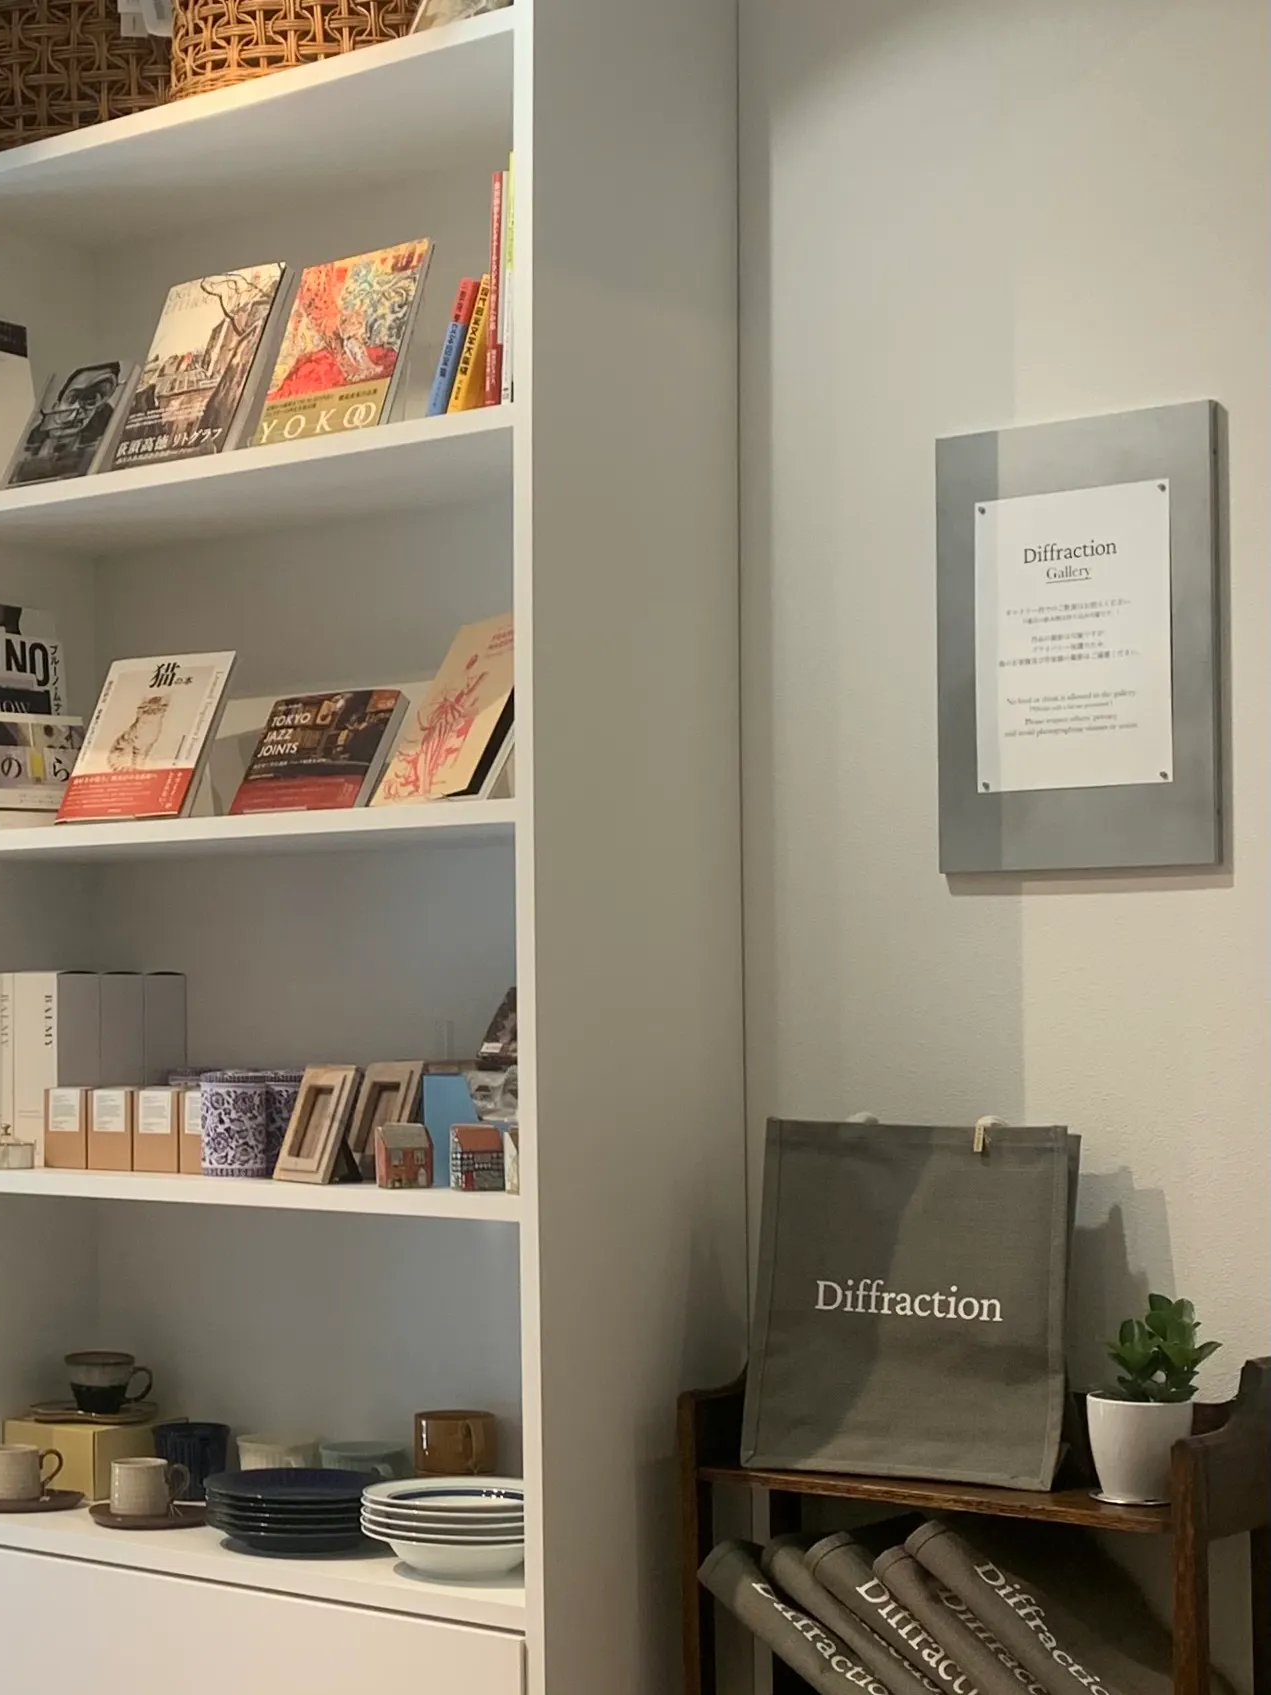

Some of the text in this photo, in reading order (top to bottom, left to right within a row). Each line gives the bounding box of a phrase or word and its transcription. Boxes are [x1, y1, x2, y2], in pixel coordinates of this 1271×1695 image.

[1023, 539, 1117, 564] Diffraction
[1046, 565, 1091, 580] Gallery
[149, 662, 194, 688] 猫の本
[272, 713, 311, 727] TOKYO
[264, 728, 294, 743] JAZZ
[257, 742, 299, 758] JOINTS
[814, 1279, 1003, 1322] Diffraction
